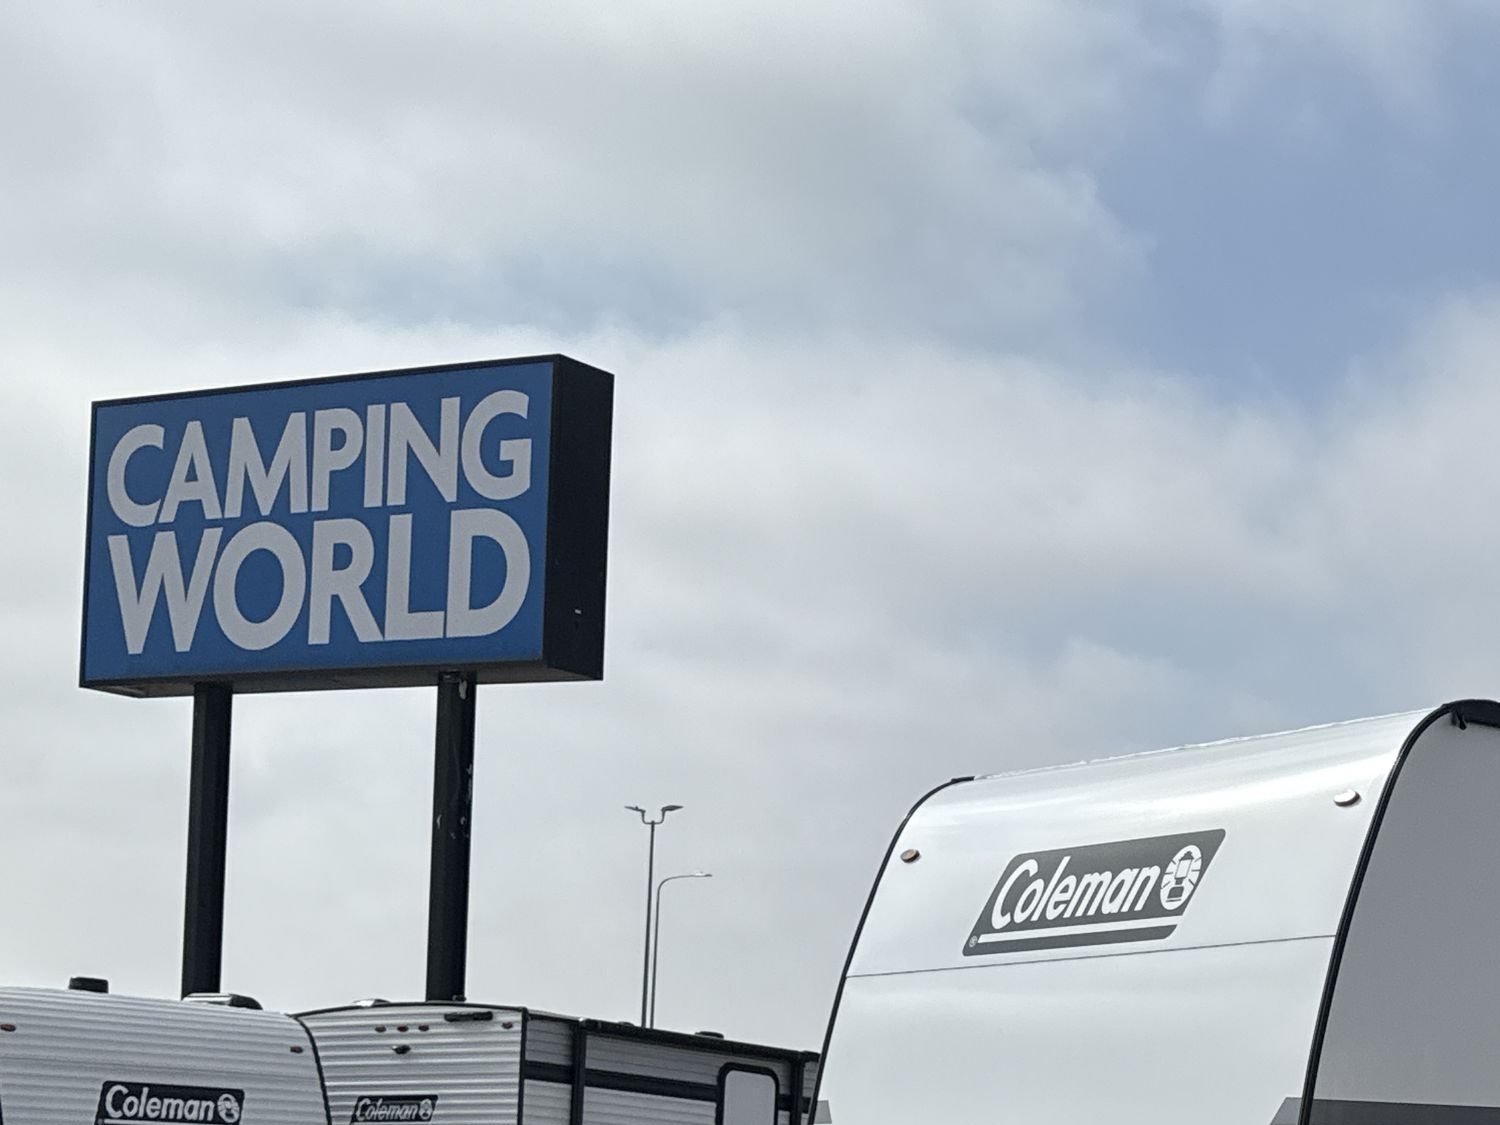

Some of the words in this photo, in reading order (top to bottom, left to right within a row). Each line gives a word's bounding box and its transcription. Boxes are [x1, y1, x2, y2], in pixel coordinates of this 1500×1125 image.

[106, 389, 533, 528] CAMPING
[107, 507, 531, 655] WORLD
[990, 855, 1162, 930] Coleman
[105, 1084, 215, 1122] Coleman
[355, 1097, 419, 1122] Coleman
